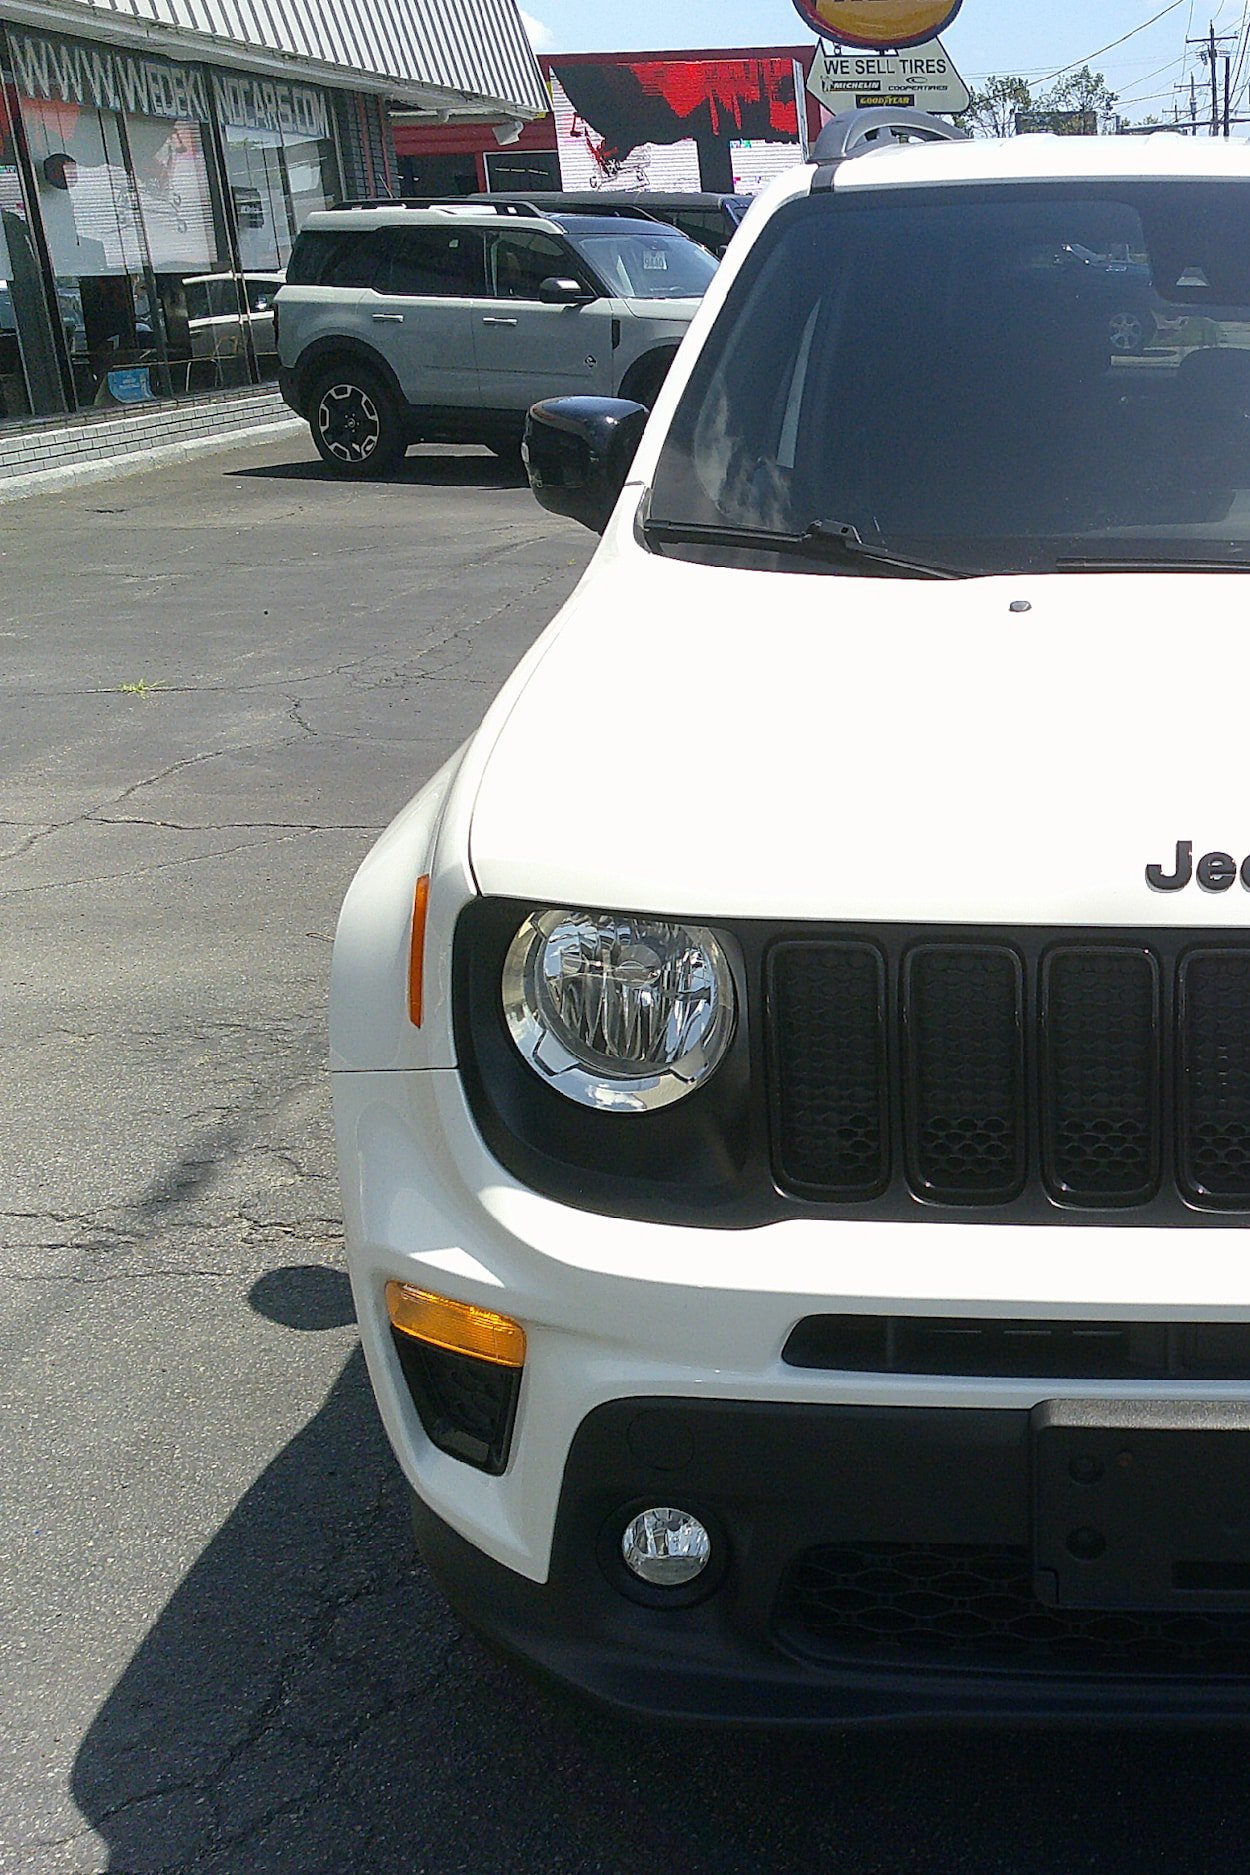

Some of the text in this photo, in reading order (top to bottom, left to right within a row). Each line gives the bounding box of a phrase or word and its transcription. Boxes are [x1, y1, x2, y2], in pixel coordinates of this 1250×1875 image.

[824, 59, 947, 75] WE SELL TIRES
[833, 81, 880, 90] MICHELIN
[860, 96, 910, 106] GOODYEAR
